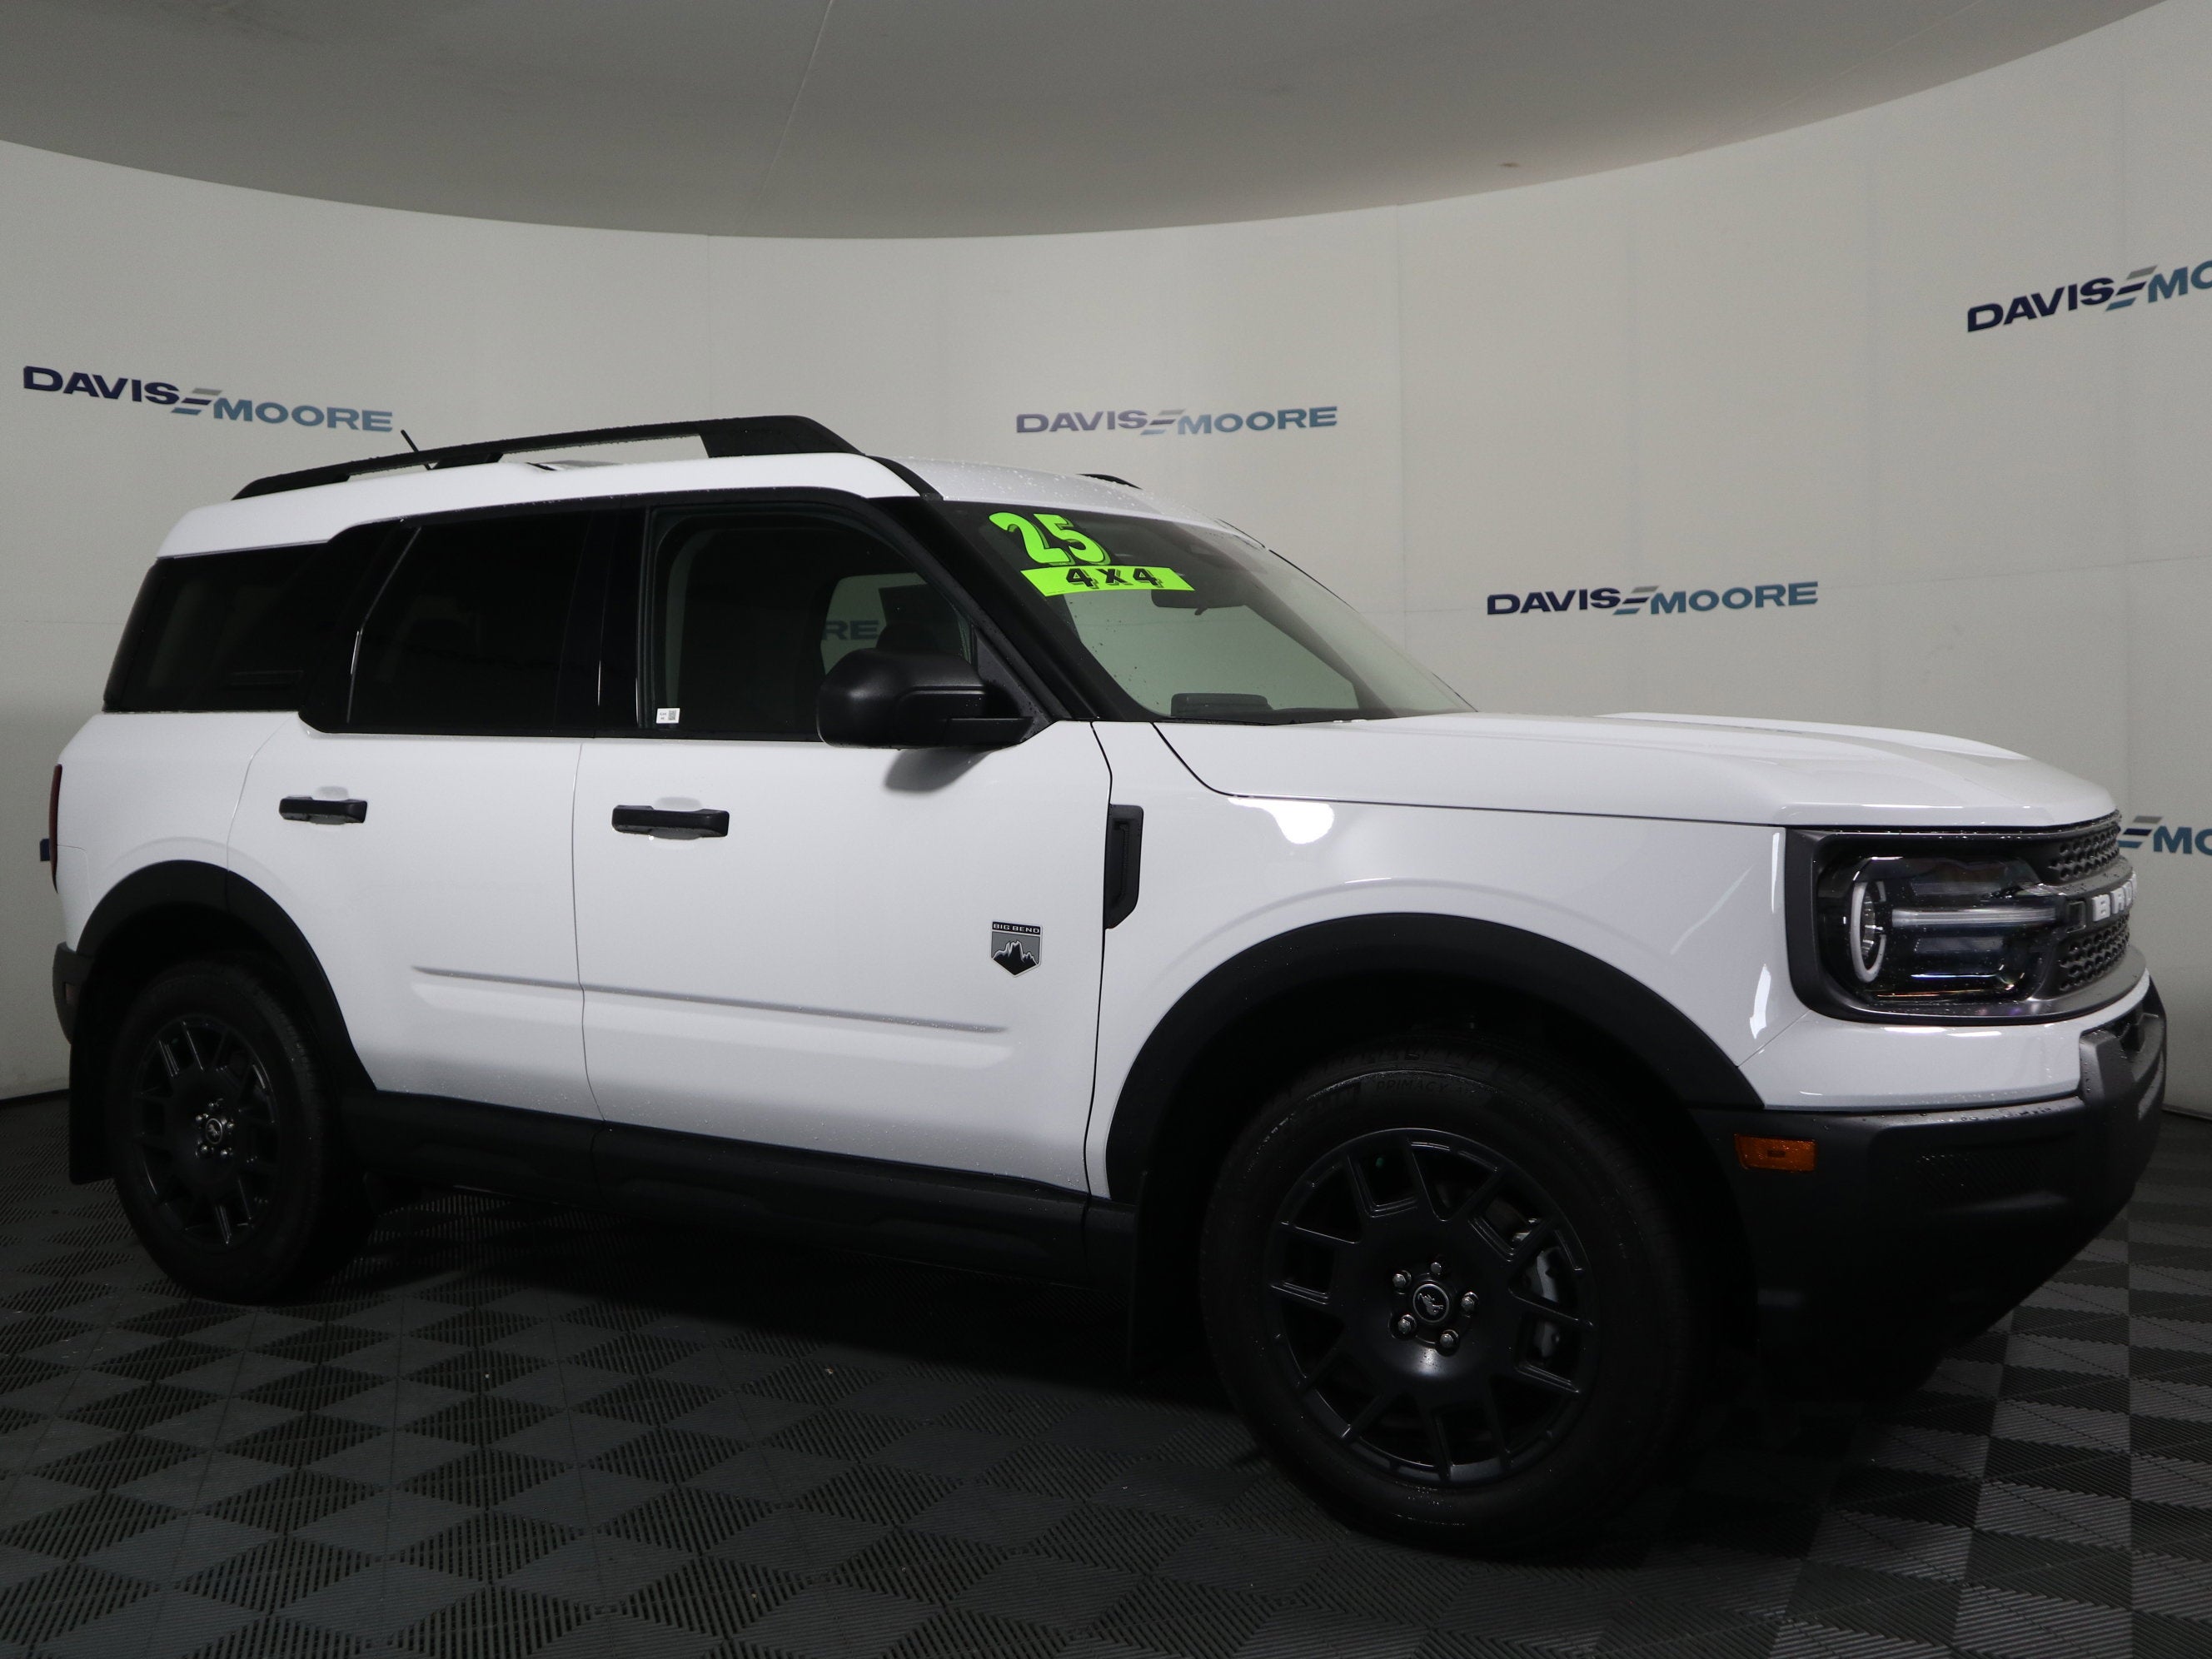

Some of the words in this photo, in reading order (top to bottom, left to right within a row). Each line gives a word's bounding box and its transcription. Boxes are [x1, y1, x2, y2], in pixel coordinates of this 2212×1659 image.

[1967, 277, 2115, 332] DAVIS
[23, 366, 179, 405] DAVIS
[213, 398, 392, 432] MOORE
[1016, 409, 1148, 434] DAVIS
[1178, 406, 1338, 435] MOORE
[989, 512, 1111, 565] 25
[1487, 587, 1621, 615] DAVIS
[1651, 581, 1818, 615] MOORE
[993, 923, 1010, 931] BIG
[1012, 925, 1040, 934] BEND
